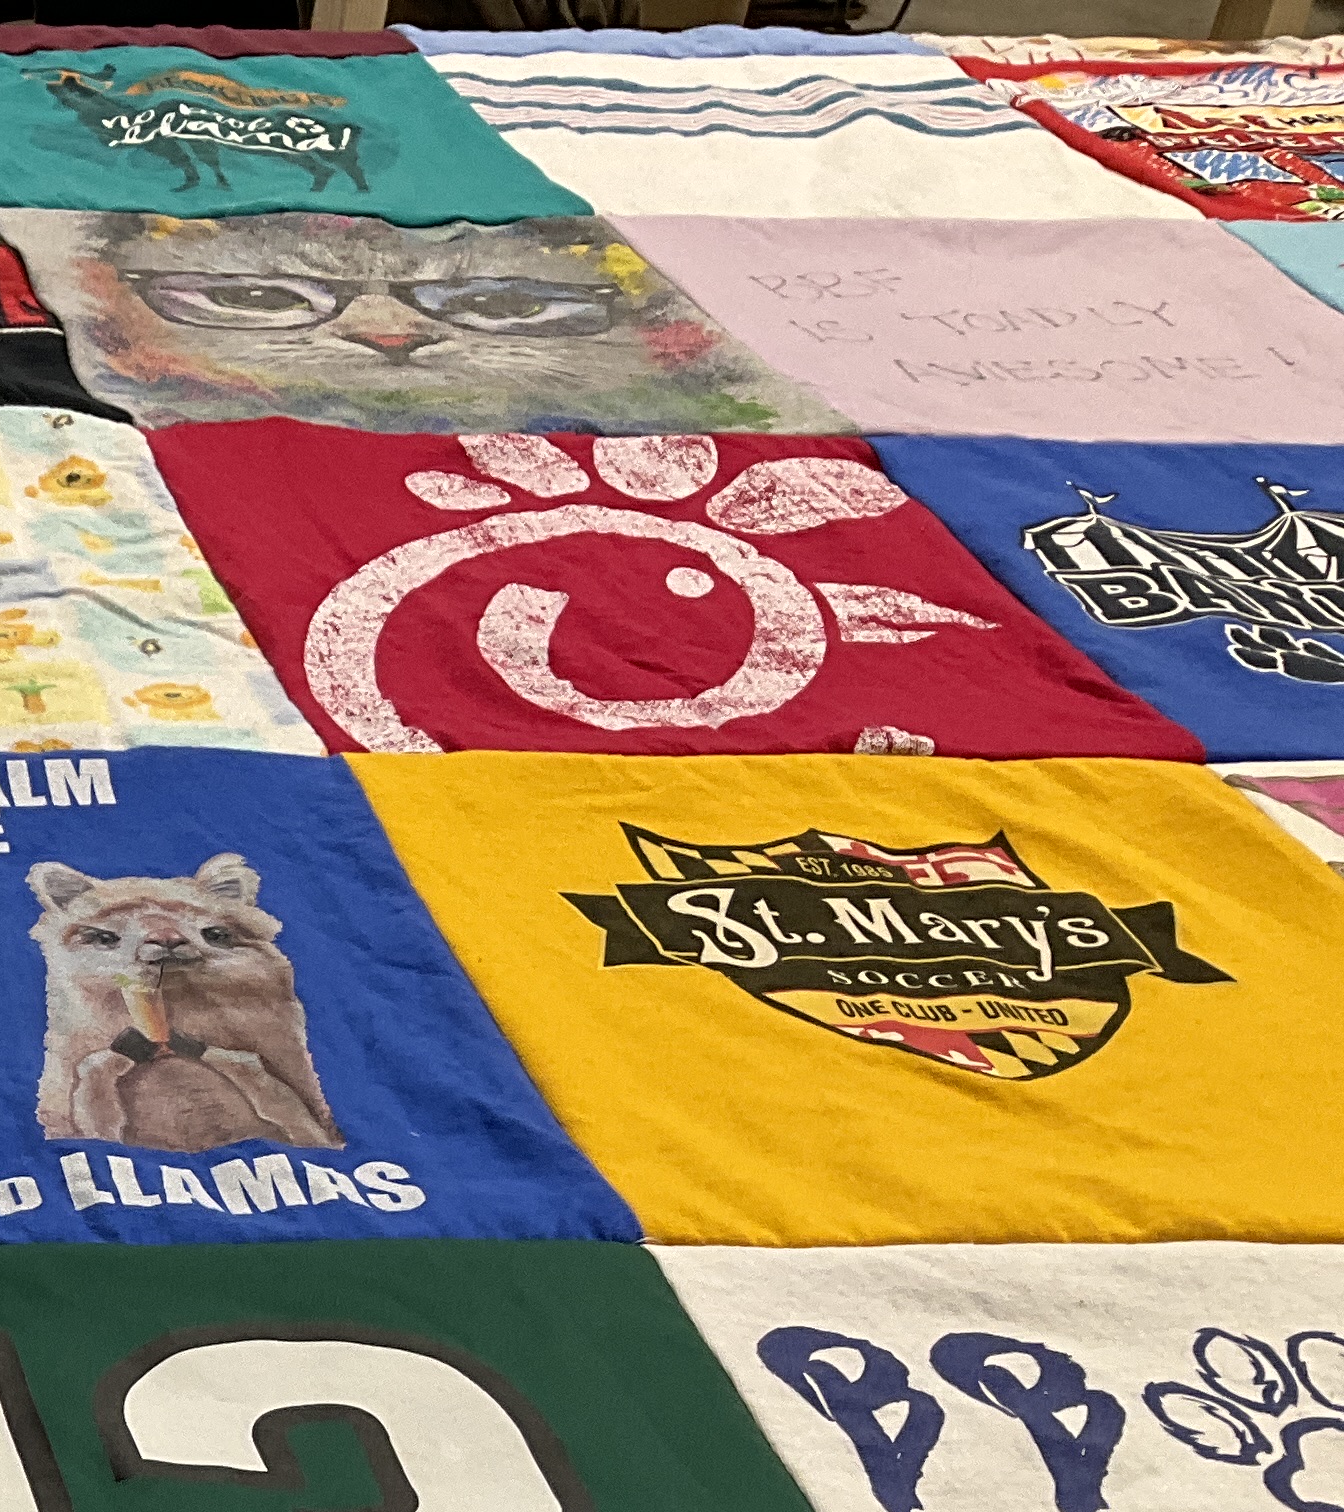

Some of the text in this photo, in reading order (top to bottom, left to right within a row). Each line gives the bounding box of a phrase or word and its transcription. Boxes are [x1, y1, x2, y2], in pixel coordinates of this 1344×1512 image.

[794, 855, 894, 880] EST. 1985
[667, 888, 1110, 983] St. Mary's
[835, 998, 892, 1019] ONE
[892, 1001, 957, 1022] CLUB
[976, 1001, 1070, 1027] UNITED
[59, 1150, 428, 1217] LLAMAS
